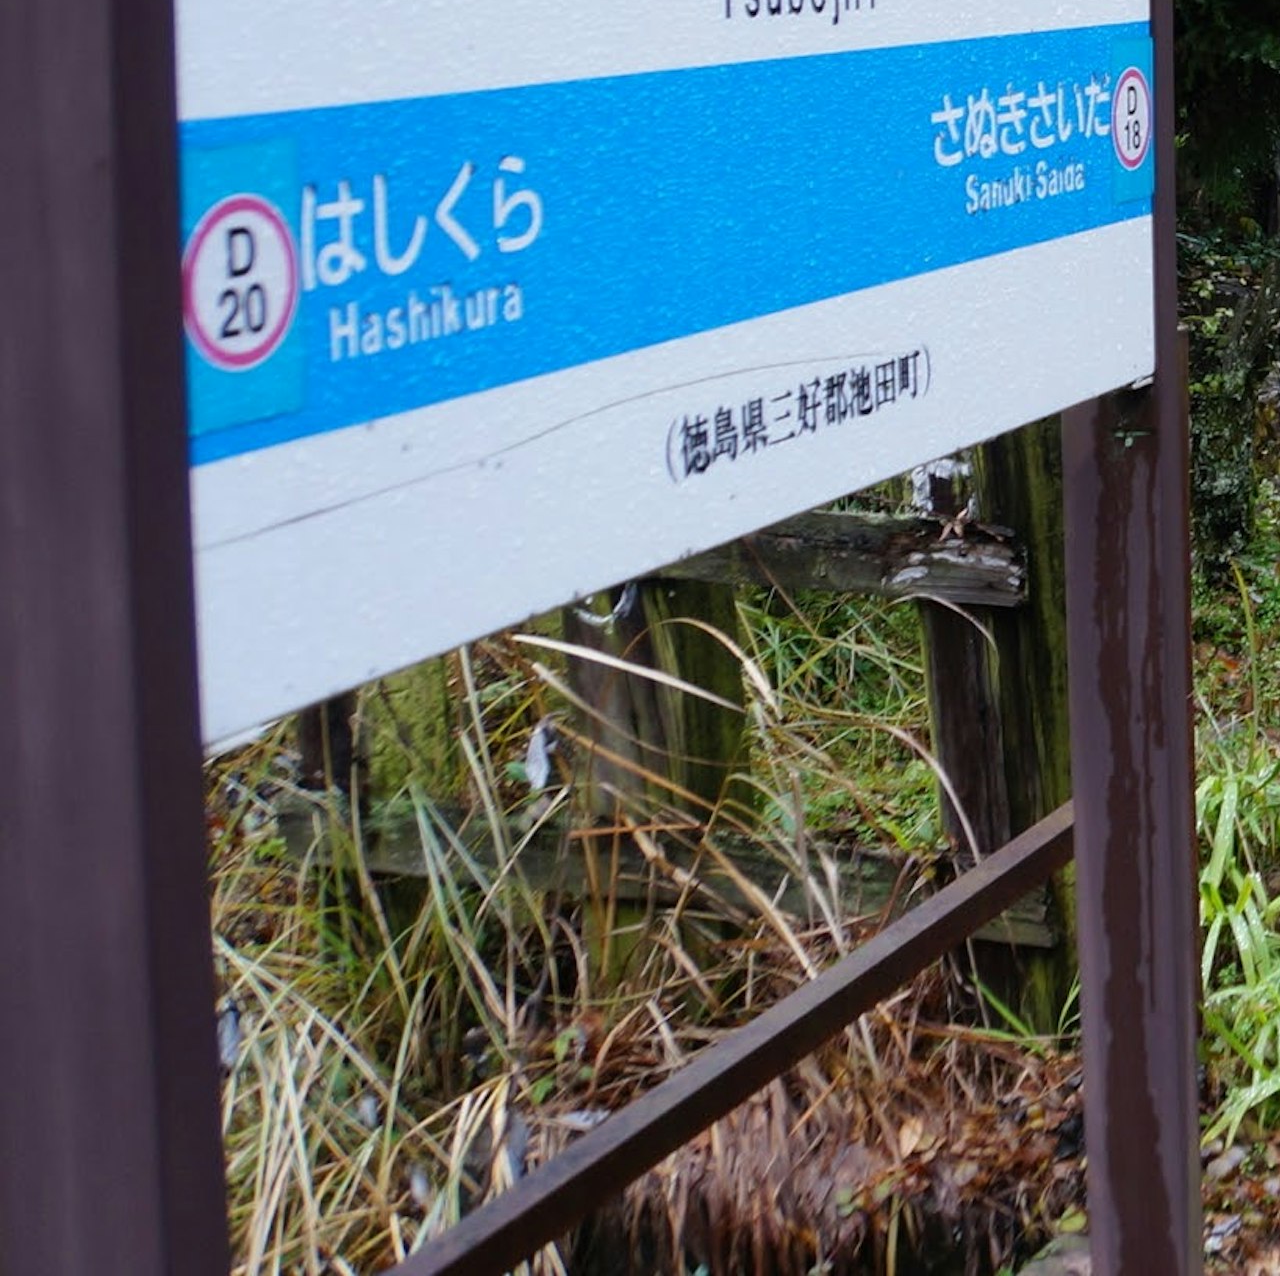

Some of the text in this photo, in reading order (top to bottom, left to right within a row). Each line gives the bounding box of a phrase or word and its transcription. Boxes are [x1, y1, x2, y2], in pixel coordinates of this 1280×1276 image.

[930, 72, 1112, 167] さぬきさいだ
[1126, 86, 1138, 117] D
[1124, 120, 1142, 151] 18
[302, 156, 543, 291] はしくら
[227, 227, 256, 278] D
[218, 283, 268, 340] 20
[330, 285, 523, 362] Hashikura
